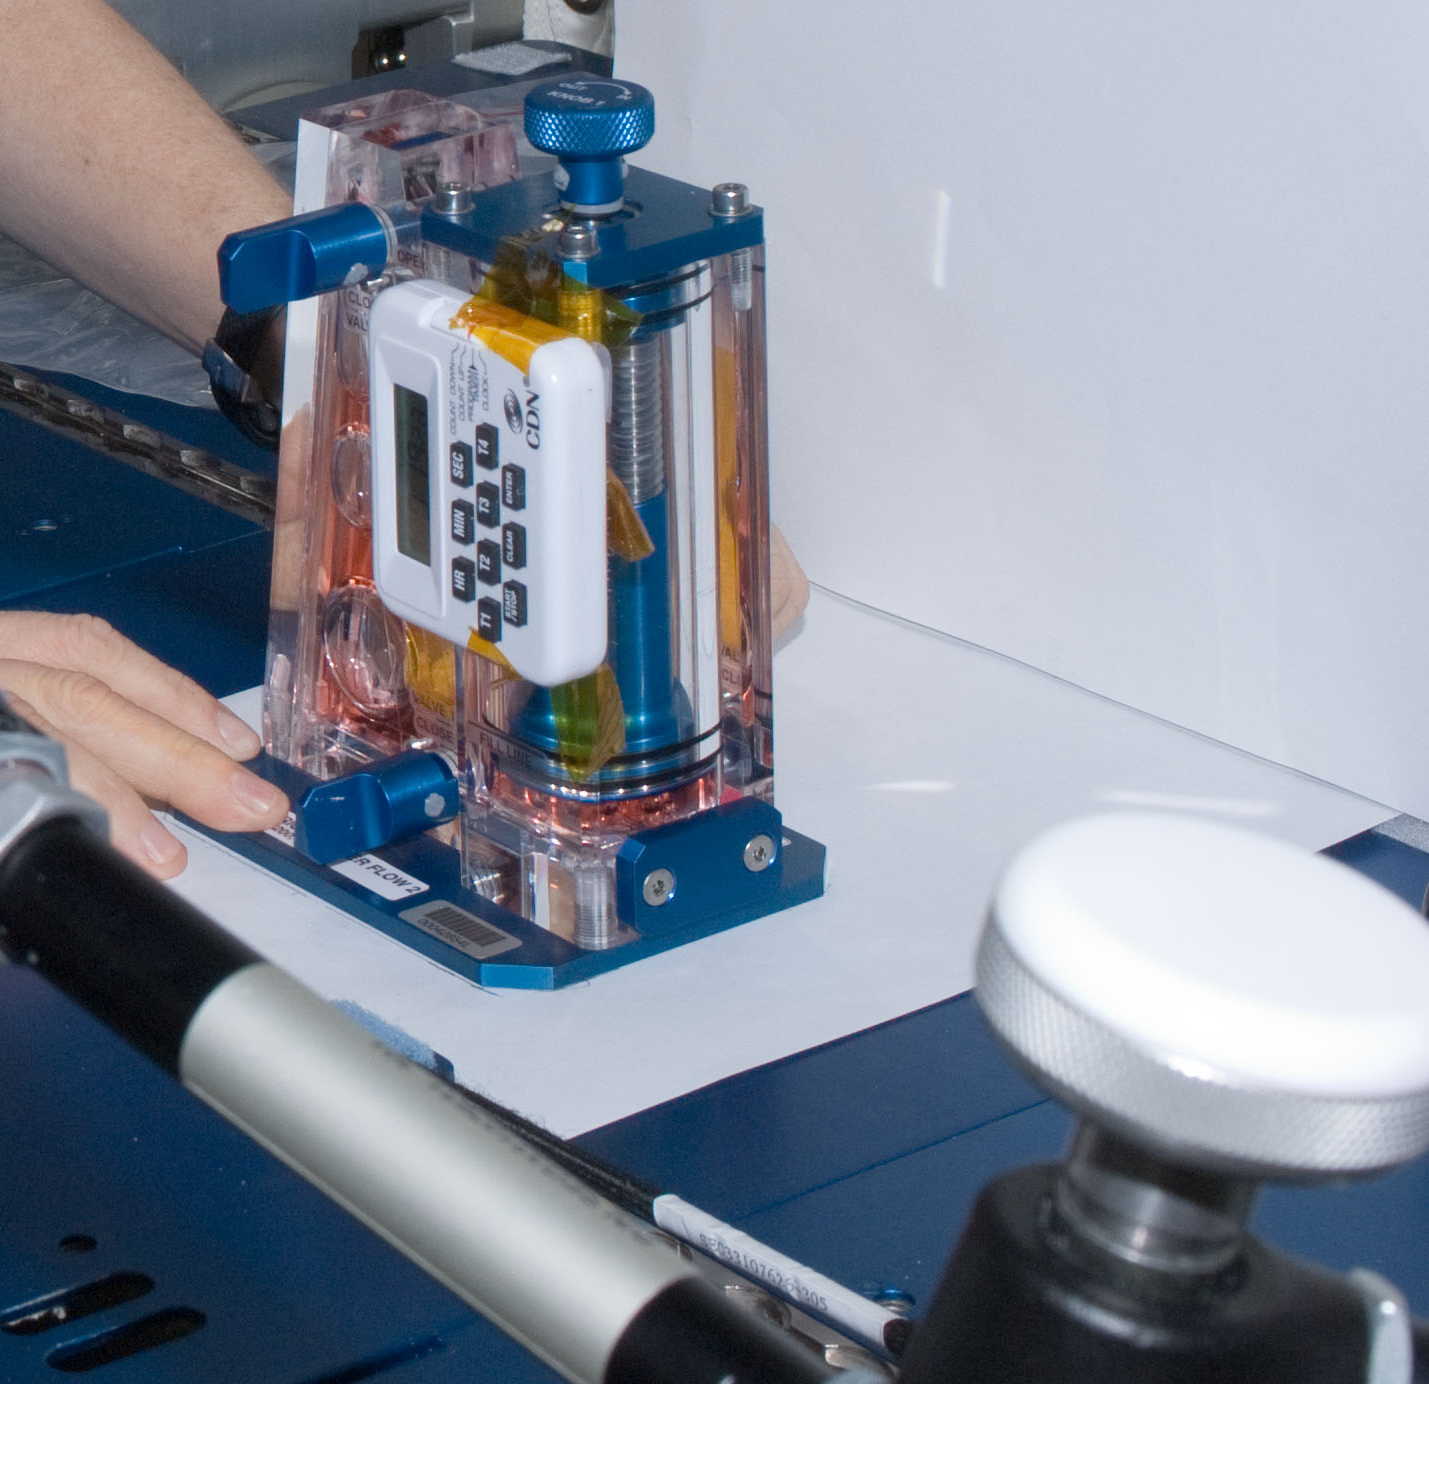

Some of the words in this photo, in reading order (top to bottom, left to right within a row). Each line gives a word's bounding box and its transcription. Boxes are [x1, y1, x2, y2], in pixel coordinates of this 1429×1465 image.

[346, 312, 369, 332] VAL
[477, 438, 490, 456] T4
[452, 451, 465, 480] SEC
[505, 471, 514, 505] ENTER
[478, 497, 490, 515] T3
[453, 509, 466, 538] MIN
[505, 530, 514, 563] CLEAR
[479, 554, 491, 572] T2
[454, 570, 466, 592] HR
[480, 612, 492, 629] T1
[415, 716, 455, 744] CLOSE
[366, 859, 410, 888] FLOW
[403, 884, 423, 895] 2
